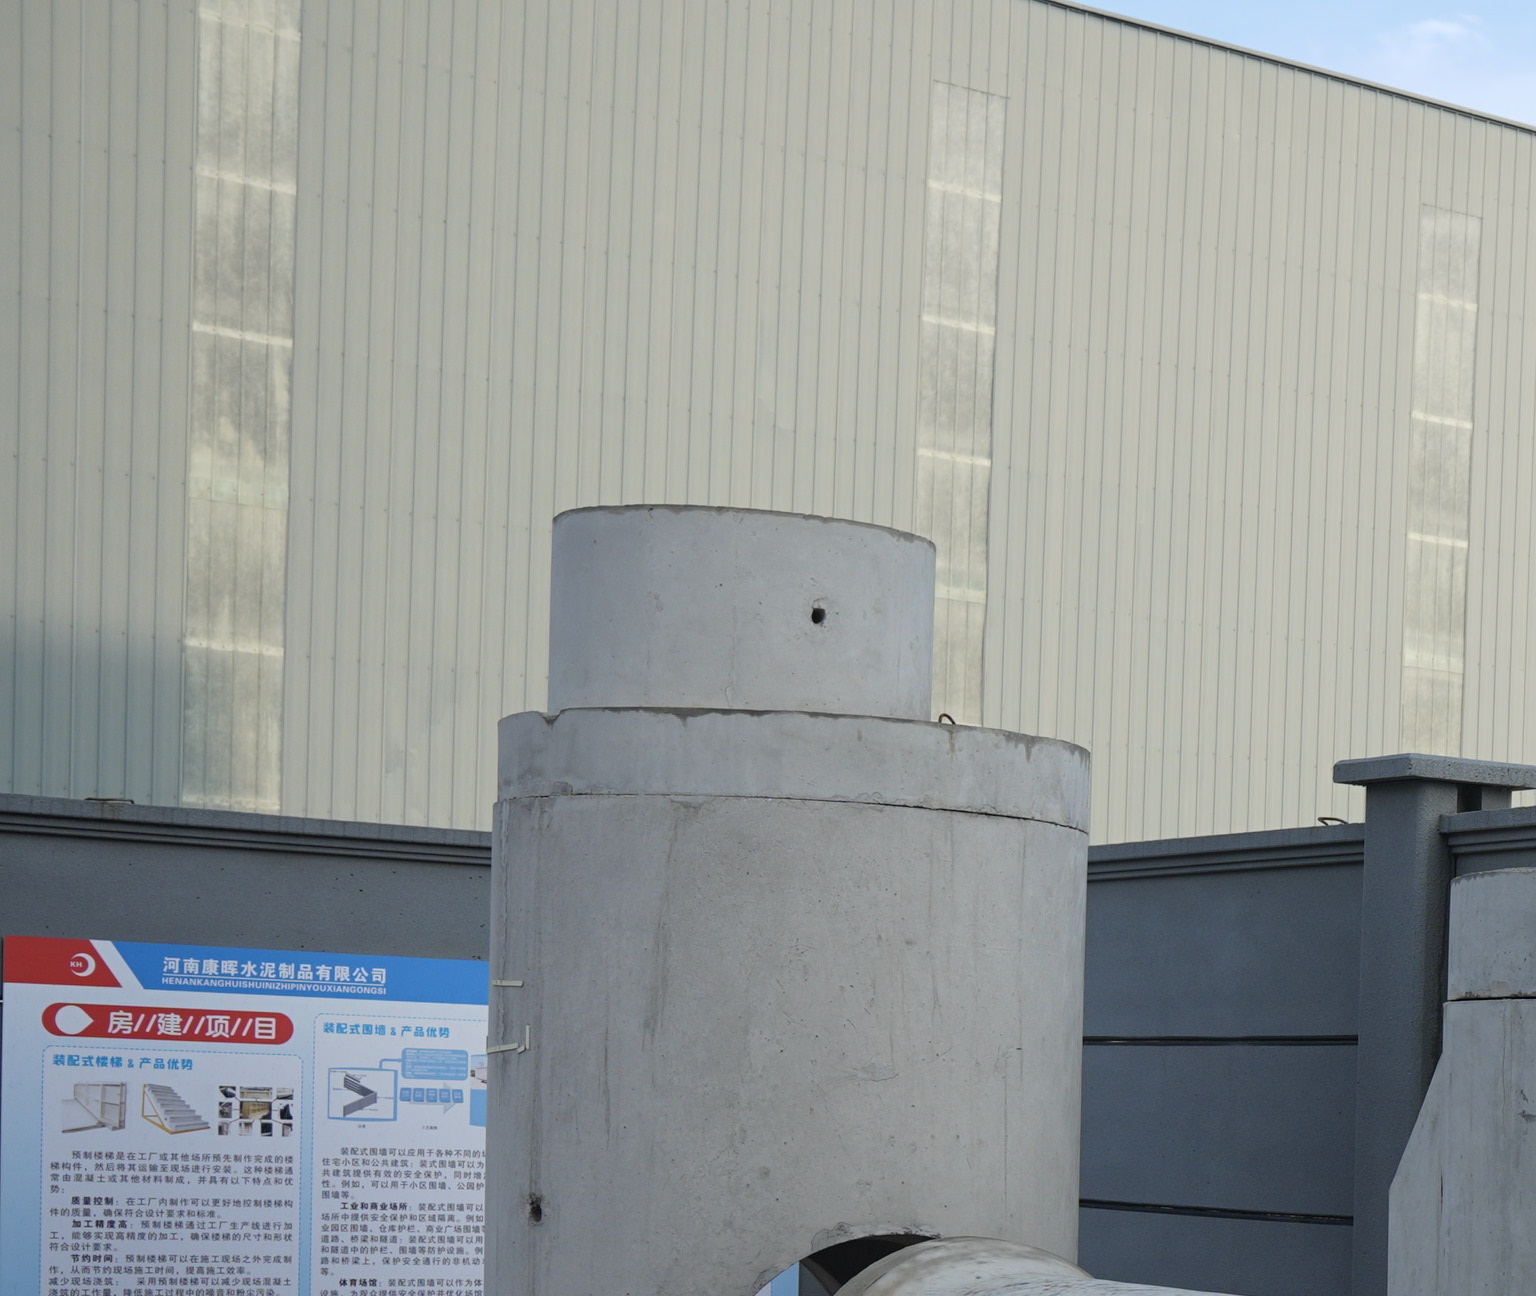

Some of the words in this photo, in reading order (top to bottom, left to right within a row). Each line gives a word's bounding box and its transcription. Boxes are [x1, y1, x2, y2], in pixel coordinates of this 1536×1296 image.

[70, 960, 82, 968] KH
[163, 957, 386, 984] 河南康晖水泥制品有限公司
[162, 977, 386, 994] HENANKANGHUISHUINIZHIPINYOUXIANGONGSI
[323, 1022, 386, 1035] 装配式围墙
[401, 1026, 449, 1038] 产品优势
[53, 1054, 122, 1068] 装配式楼梯
[128, 1060, 134, 1068] &
[139, 1058, 193, 1070] 产品优势
[72, 1151, 293, 1165] 预制楼梯是在工厂或其他场所预先制作完成的楼
[50, 1173, 293, 1187] 常由混凝土或其他材料制成，并具有以下特点和优
[50, 1184, 65, 1195] 势：
[322, 1190, 354, 1201] 围墙等。
[71, 1196, 293, 1208] 质量控制：在工厂内制作可以更好地控制楼梯构
[340, 1201, 483, 1213] 工业和商业场所：装配式围墙可以
[72, 1219, 293, 1231] 加工精度高：预制楼梯通过工厂生产线进行加
[49, 1242, 118, 1252] 符合设计要求。
[70, 1254, 292, 1264] 节约时间：预制楼梯可以在施工现场之外完成制
[321, 1267, 334, 1277] 等。
[49, 1276, 119, 1287] 减少现场浇筑：
[136, 1277, 291, 1287] 采用预制楼梯可以减少现场混凝土
[339, 1278, 482, 1288] 体育场馆：装配式围墙可以作为体
